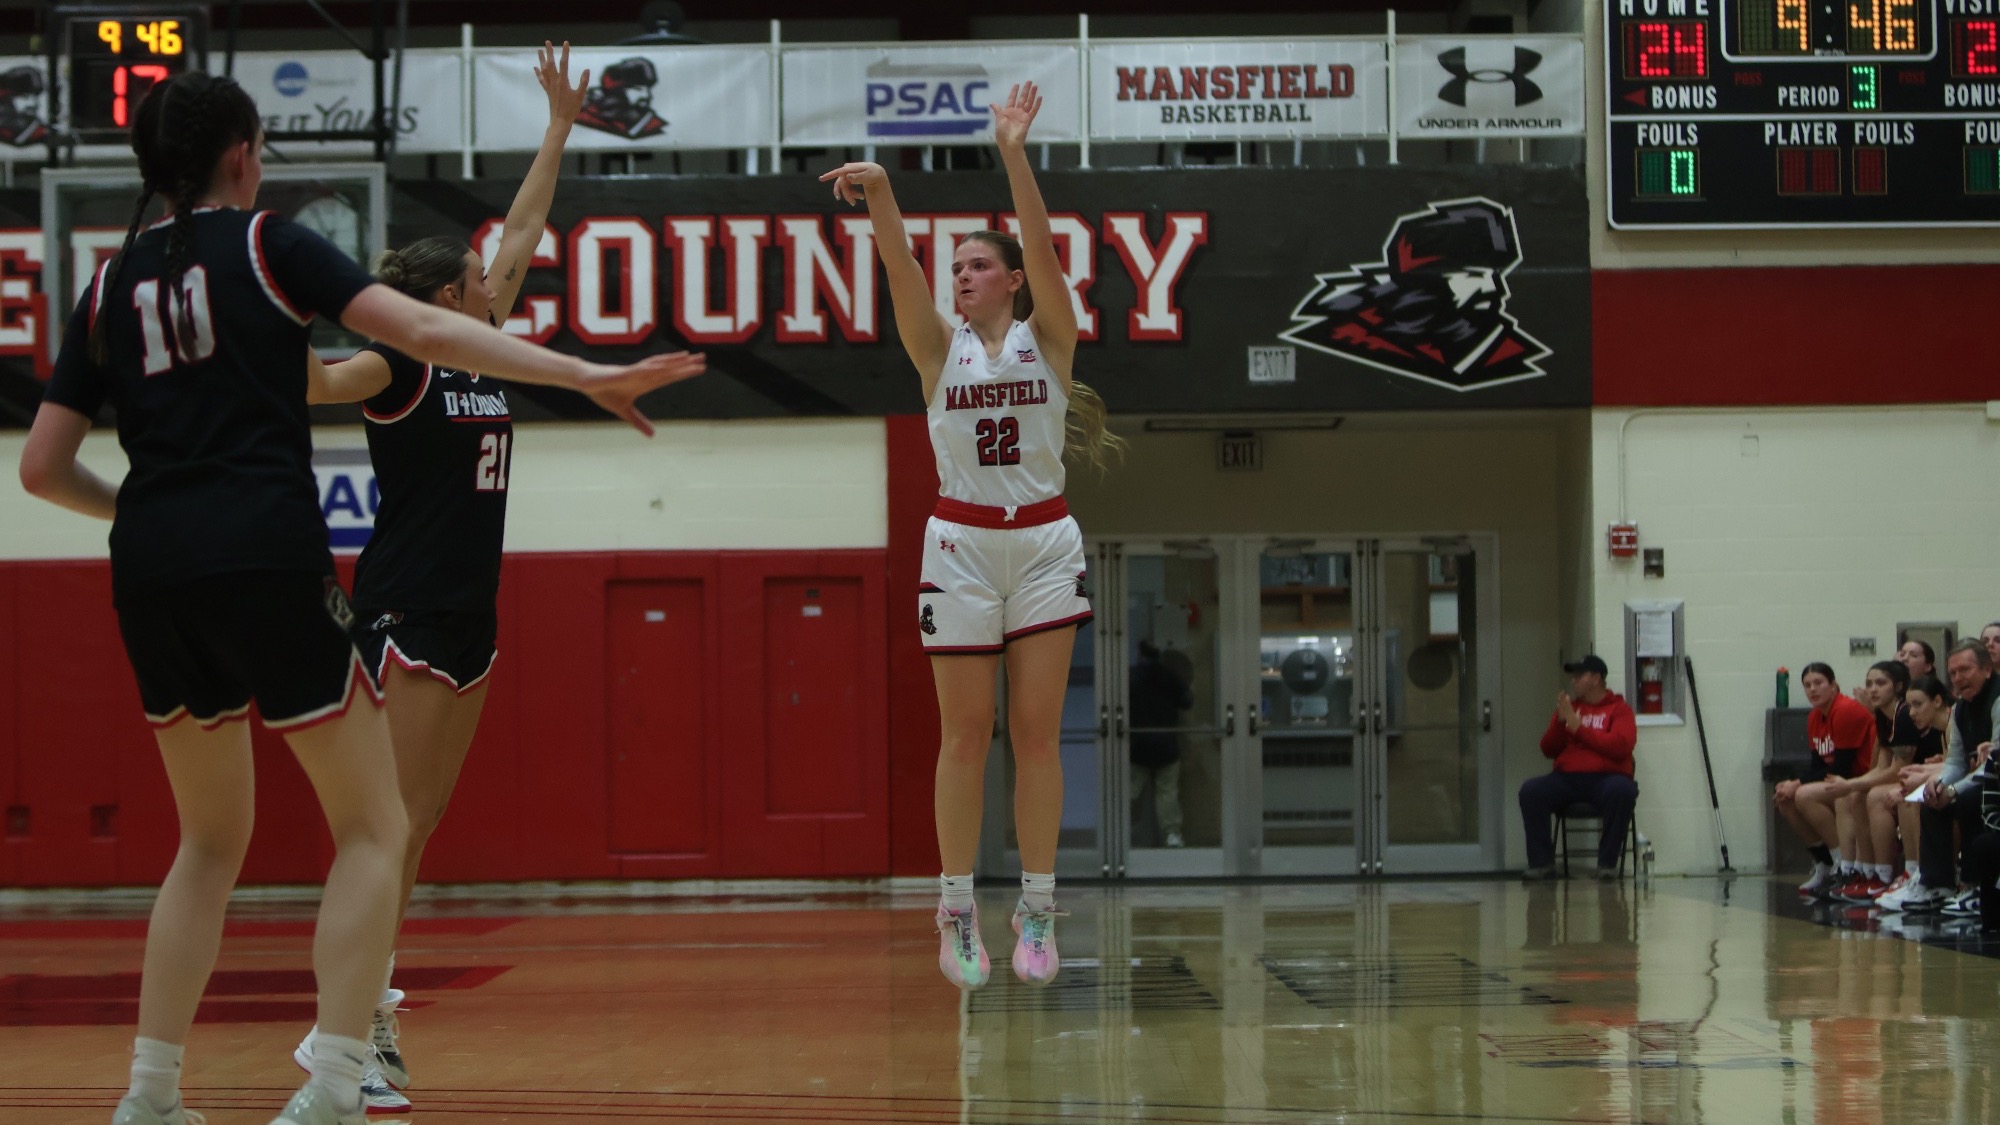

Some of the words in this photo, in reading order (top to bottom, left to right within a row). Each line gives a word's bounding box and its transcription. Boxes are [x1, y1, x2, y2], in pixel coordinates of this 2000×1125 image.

[1619, 0, 1709, 16] HOME
[1945, 0, 2000, 14] VISI
[1639, 23, 1705, 76] 24
[1116, 64, 1355, 101] MANSFIELD
[1852, 66, 1876, 109] 3
[1944, 84, 2000, 107] BONU
[866, 82, 989, 116] PSAC
[1652, 85, 1718, 109] BONUS
[1778, 86, 1840, 107] PERIOD
[1160, 104, 1312, 124] BASKETBALL
[1418, 118, 1479, 129] UNDER
[1485, 118, 1562, 129] ARMOUR
[1637, 122, 1698, 146] FOULS
[1764, 122, 1838, 145] PLAYER
[1854, 121, 1915, 145] FOULS
[1670, 151, 1694, 194] 0
[133, 265, 216, 377] 10
[1254, 350, 1290, 377] EXIT
[945, 379, 1048, 411] MANSFIELD
[976, 416, 1020, 466] 22
[1222, 441, 1254, 467] EXIT
[475, 432, 508, 491] 21
